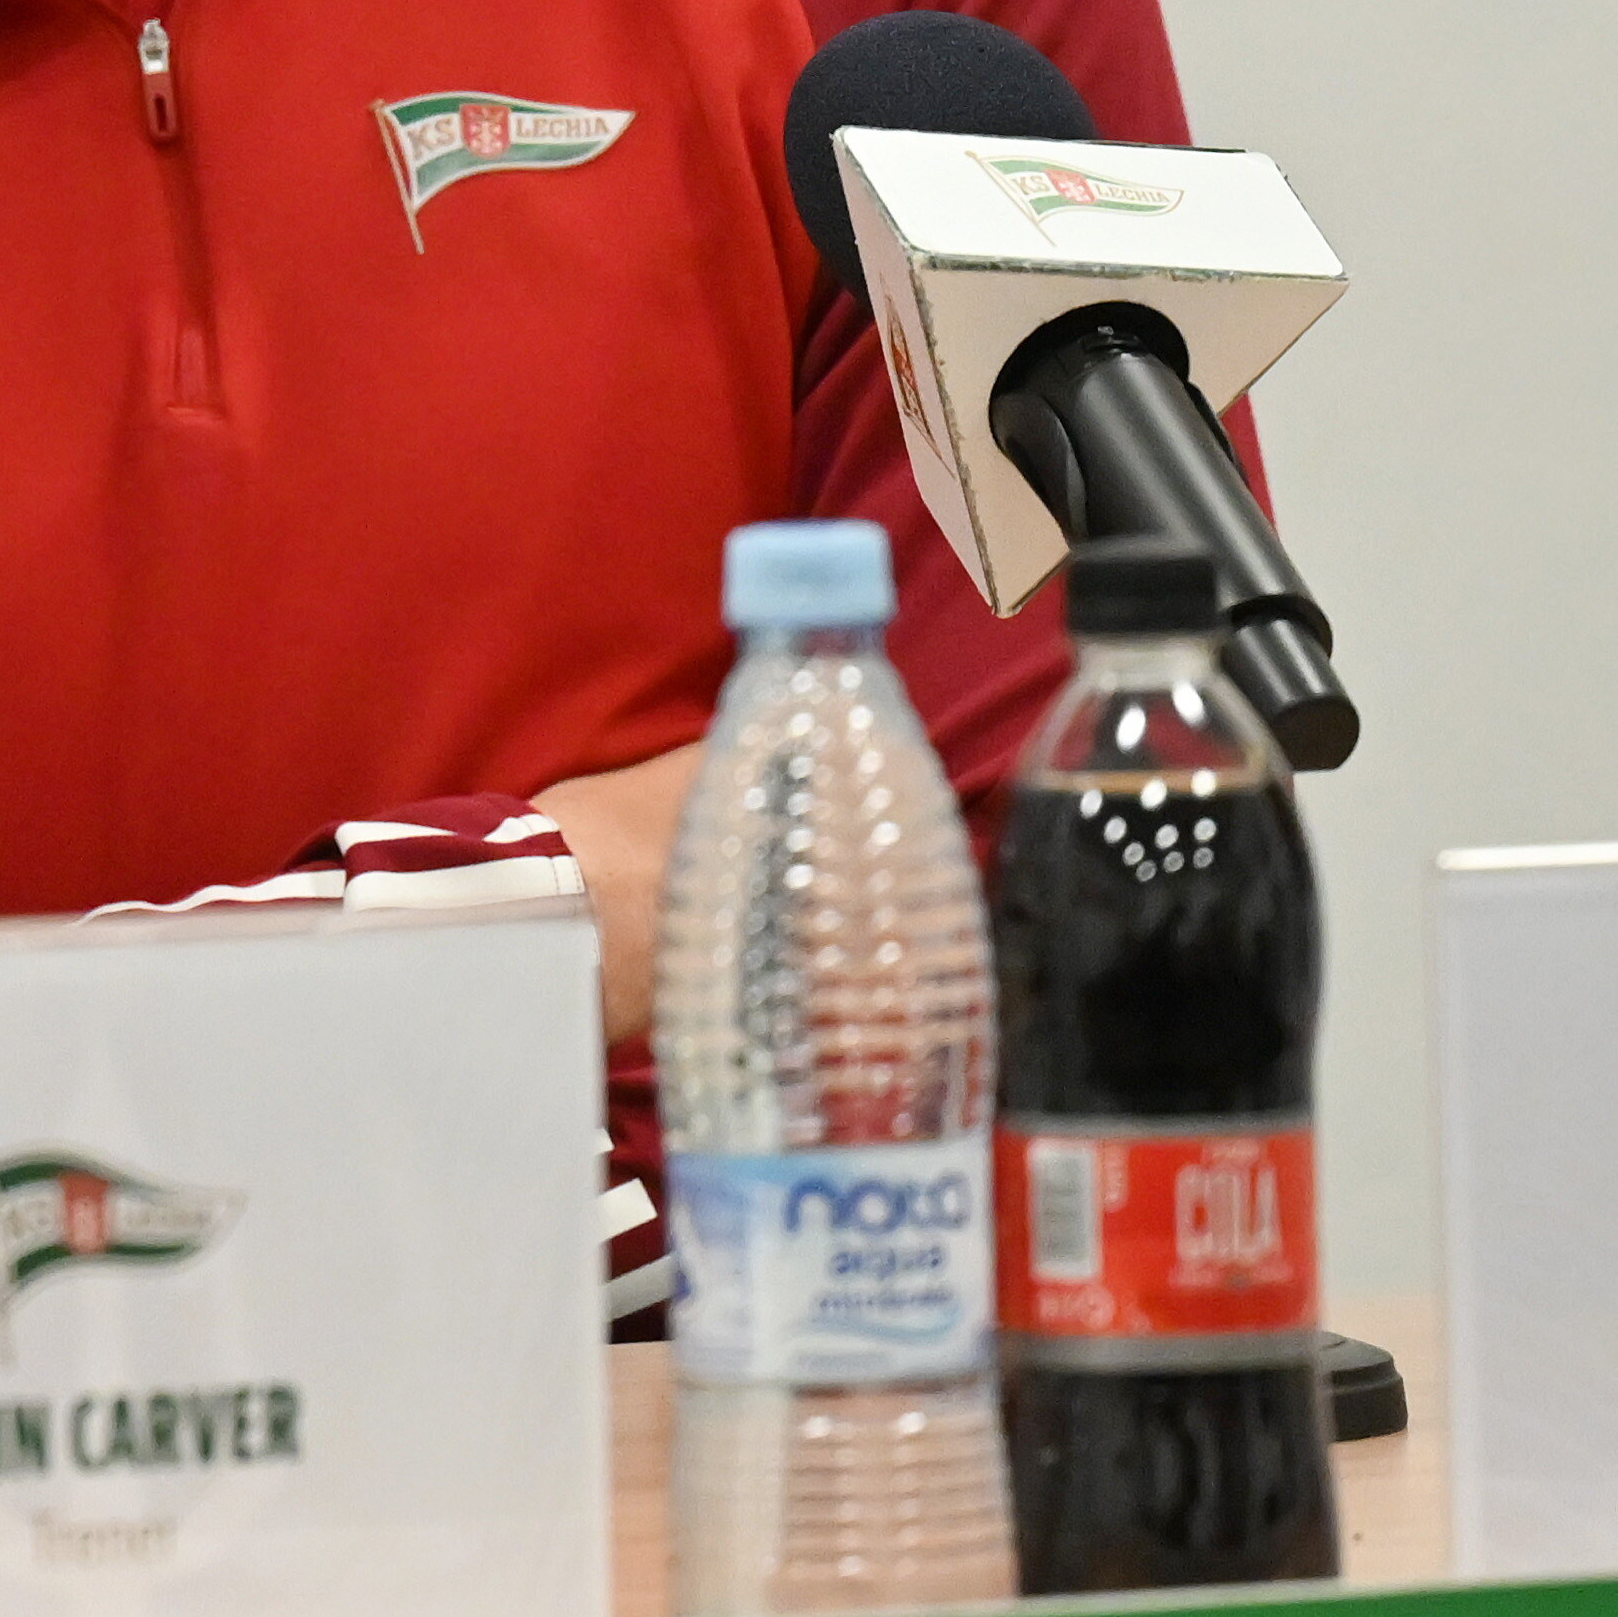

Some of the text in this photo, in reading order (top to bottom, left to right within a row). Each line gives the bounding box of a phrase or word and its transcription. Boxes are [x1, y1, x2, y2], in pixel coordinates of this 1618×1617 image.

[406, 115, 610, 160] KS LECHIA
[1012, 173, 1171, 204] KS LECHIA
[71, 1380, 300, 1474] CARVER
